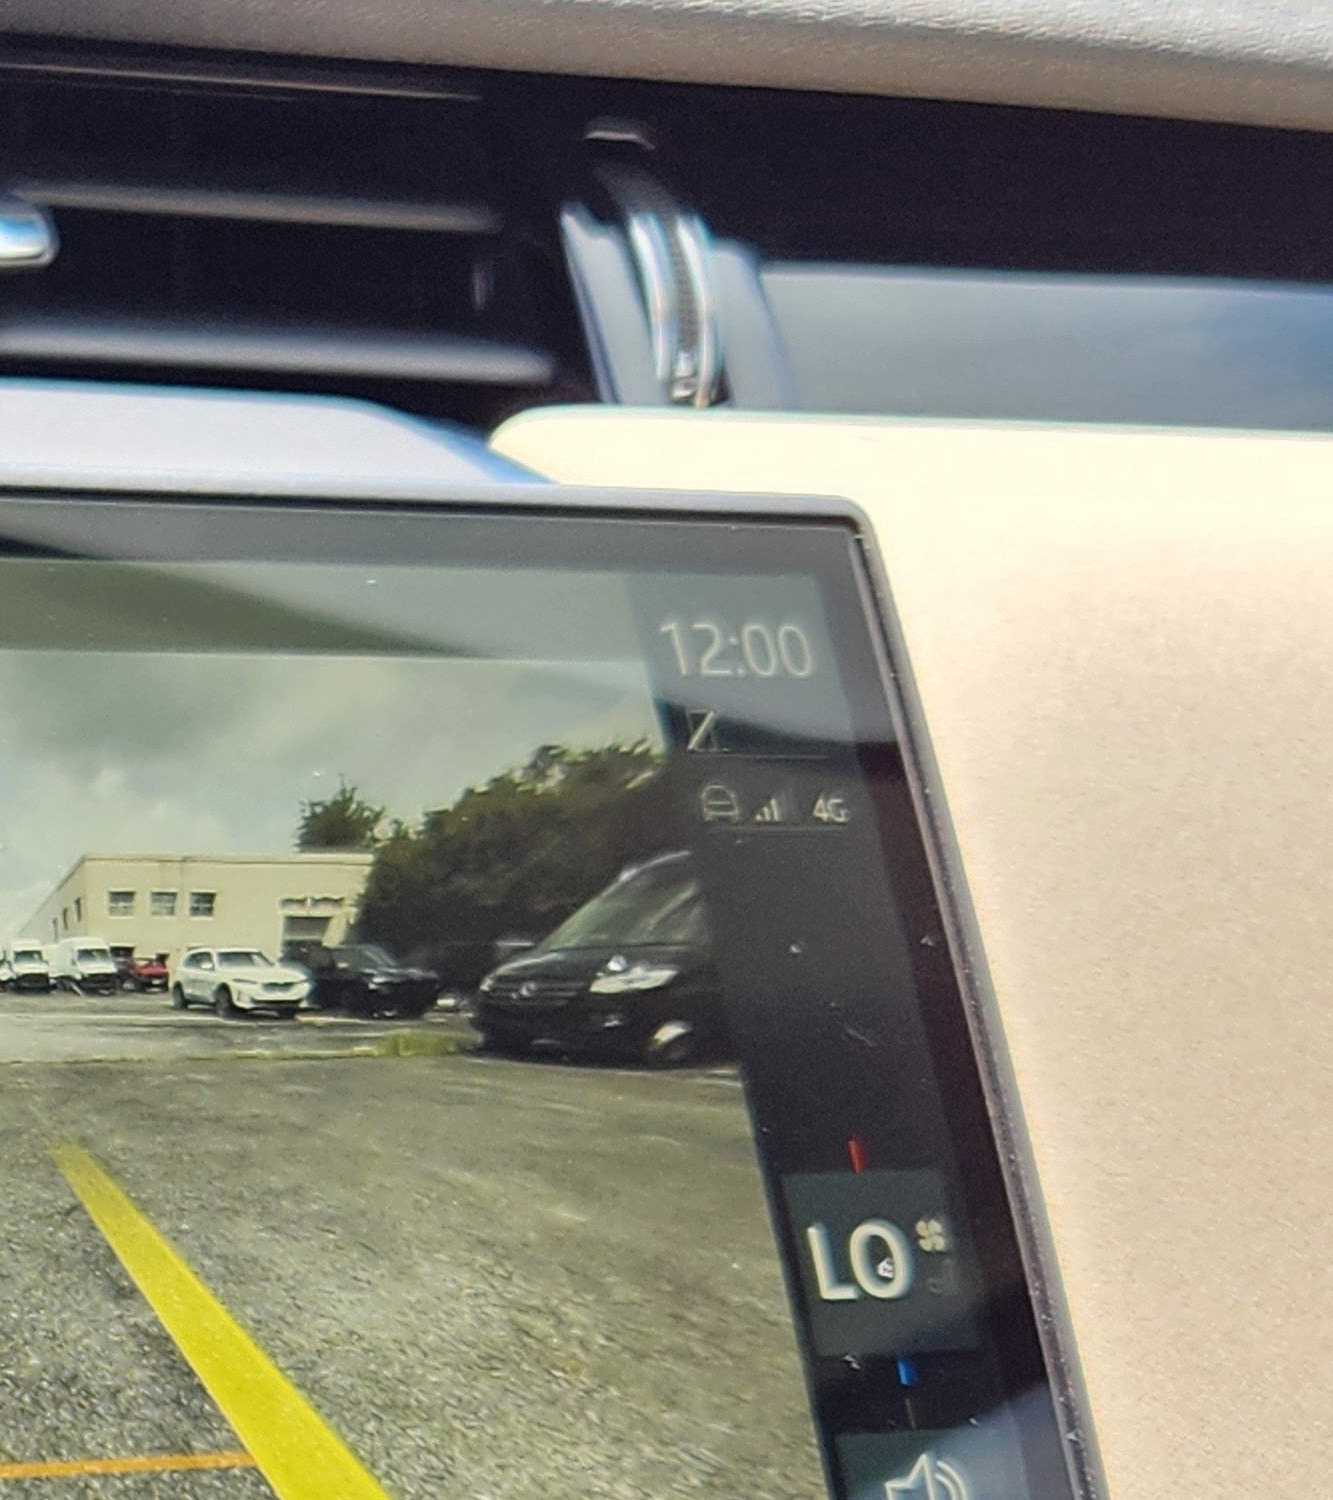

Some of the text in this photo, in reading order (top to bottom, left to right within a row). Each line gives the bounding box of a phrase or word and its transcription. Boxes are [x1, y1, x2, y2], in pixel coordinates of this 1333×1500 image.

[659, 617, 813, 679] 12:00
[812, 795, 851, 825] 4G
[807, 1218, 915, 1302] LO
